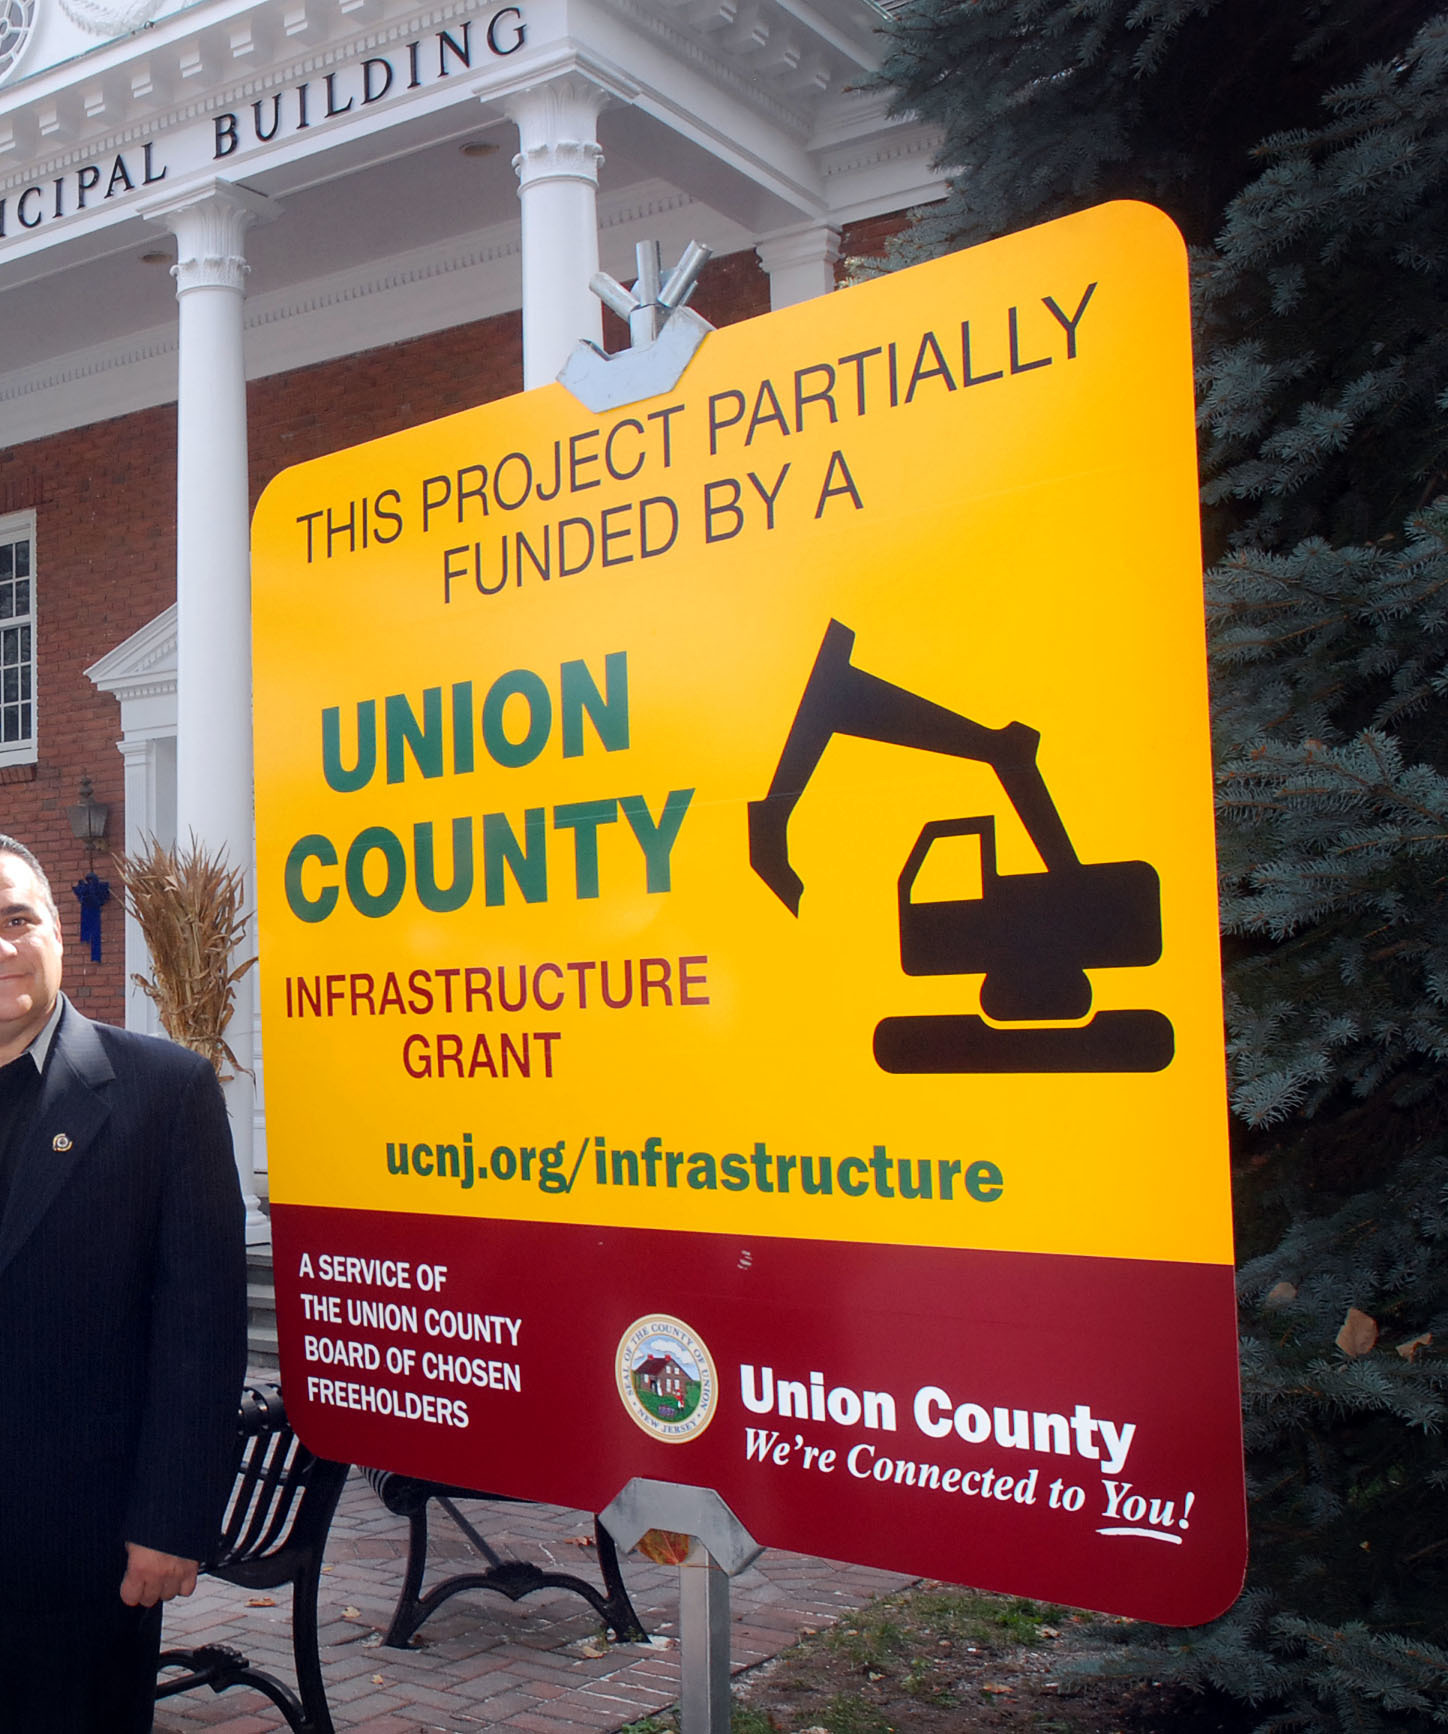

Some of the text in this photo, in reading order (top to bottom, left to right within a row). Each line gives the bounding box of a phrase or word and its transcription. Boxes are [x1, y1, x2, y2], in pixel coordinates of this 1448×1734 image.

[212, 7, 527, 160] BUILDING
[296, 281, 1099, 564] THIS PROJECT PARTIALLY
[443, 449, 865, 604] FUNDED BY A
[321, 650, 631, 794] UNION
[284, 787, 697, 924] COUNTY
[285, 955, 710, 1018] INFRASTRUCTURE
[403, 1032, 562, 1079] GRANT
[385, 1132, 1004, 1203] ucnj.org/infrastructure
[299, 1252, 448, 1292] A SERVICE OF
[300, 1293, 522, 1346] THE UNION COUNTY
[304, 1335, 521, 1393] BOARD OF CHOSEN
[307, 1376, 469, 1428] FREEHOLDERS
[623, 1323, 711, 1411] SEAL OF THE COUNTY OF UNION
[637, 1409, 660, 1428] NEW
[662, 1420, 697, 1433] JERSEY
[740, 1364, 1137, 1475] Union County
[745, 1427, 1195, 1530] We're Connected to You!
